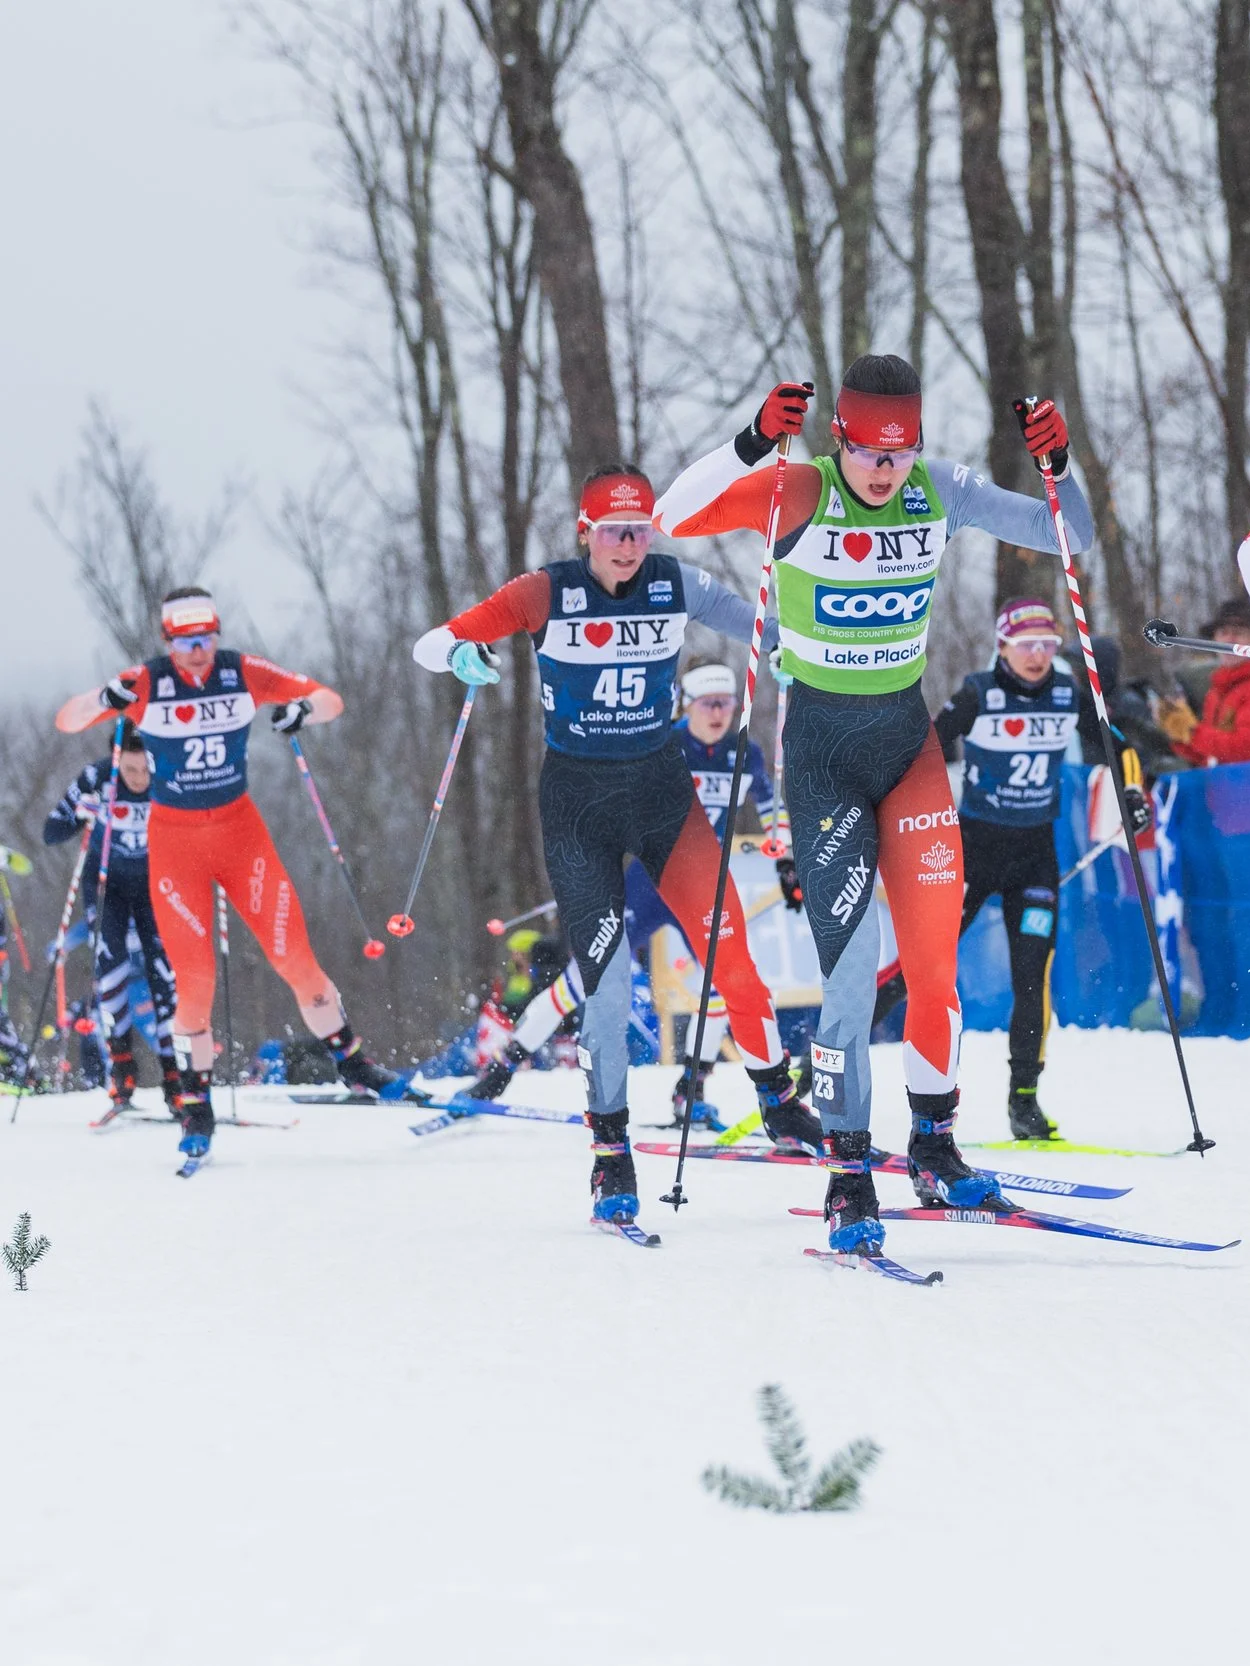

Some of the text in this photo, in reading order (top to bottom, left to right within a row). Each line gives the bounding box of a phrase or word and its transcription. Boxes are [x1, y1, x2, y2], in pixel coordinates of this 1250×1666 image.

[905, 501, 929, 512] coop
[824, 530, 840, 560] I
[877, 558, 935, 574] iloveny.com
[650, 594, 673, 603] coop
[821, 588, 931, 621] coop
[567, 622, 581, 647] I
[813, 625, 826, 635] FIS
[828, 628, 856, 639] CROSS
[857, 629, 894, 638] COUNTRY
[617, 646, 670, 658] iloveny.com
[825, 642, 921, 664] Lake Placid
[592, 667, 647, 708] 45
[162, 700, 239, 725] I NY
[579, 706, 655, 723] Lake Placid
[589, 726, 601, 734] MT
[602, 727, 620, 735] VAN
[991, 717, 1067, 737] I NY
[184, 735, 226, 770] 25
[175, 770, 203, 783] Lake
[204, 764, 235, 781] Placid
[1009, 753, 1049, 787] 24
[816, 806, 862, 866] HAYWOOD
[918, 871, 956, 882] nordiq
[166, 891, 206, 938] Sunrise
[822, 1053, 840, 1066] NY
[814, 1073, 835, 1101] 23
[995, 1173, 1078, 1195] SALOMON
[944, 1209, 995, 1225] SALOMON
